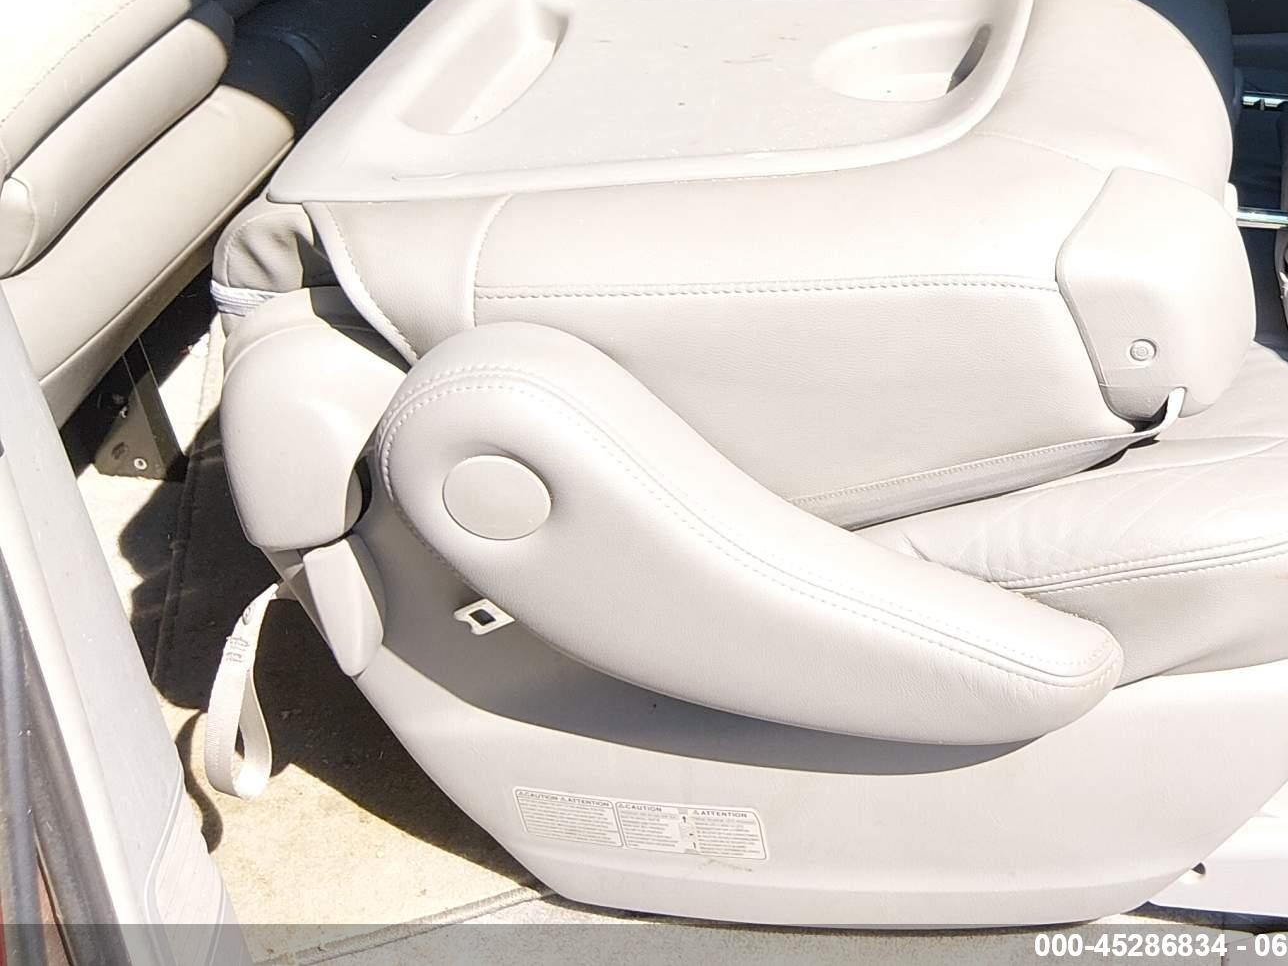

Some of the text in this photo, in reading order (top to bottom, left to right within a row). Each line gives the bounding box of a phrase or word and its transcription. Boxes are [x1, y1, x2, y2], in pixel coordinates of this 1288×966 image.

[568, 797, 610, 807] ATTENTION
[625, 804, 662, 812] CAUTION
[701, 810, 748, 819] ATTENTION
